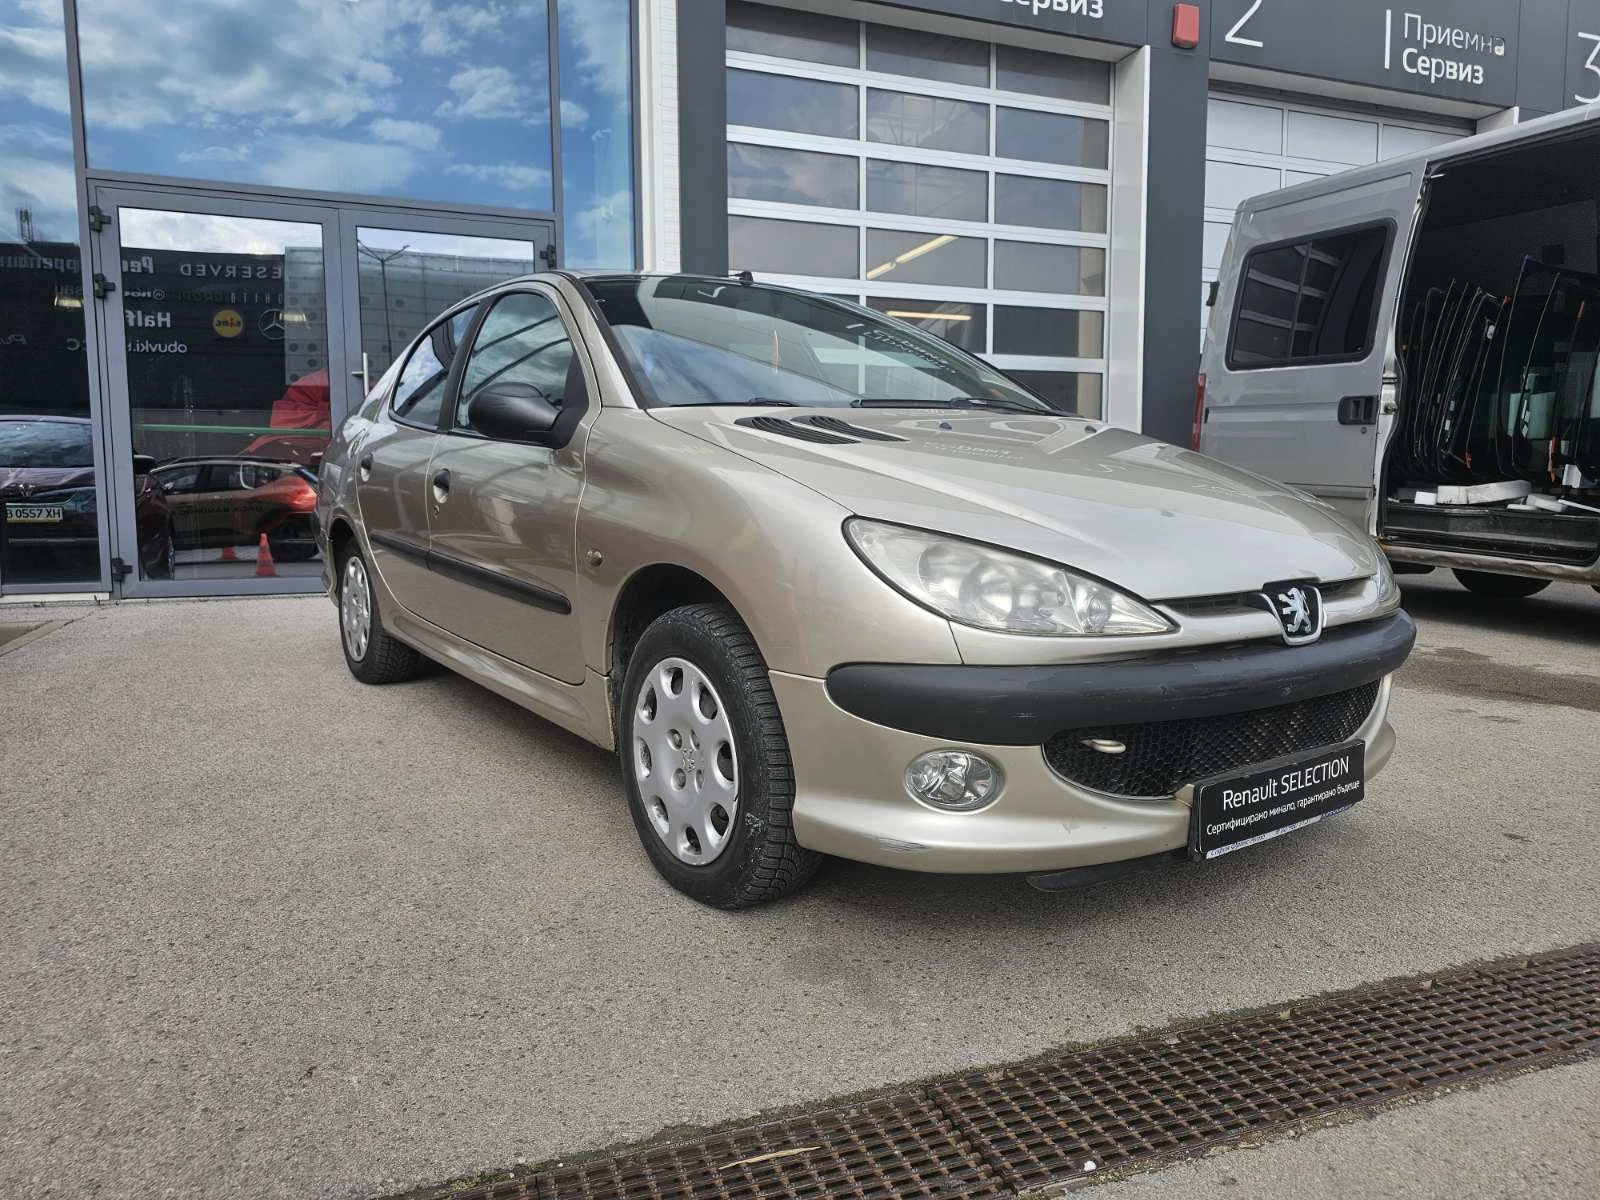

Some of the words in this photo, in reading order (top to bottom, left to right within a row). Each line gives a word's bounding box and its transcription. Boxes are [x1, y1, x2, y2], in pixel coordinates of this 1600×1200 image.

[1225, 0, 1263, 47] 2
[1404, 13, 1505, 56] Приемна
[1402, 48, 1484, 85] Сервиз
[1574, 32, 1600, 104] 3
[15, 508, 42, 519] 0557
[46, 508, 61, 519] XH
[1223, 778, 1277, 811] Renault
[1281, 756, 1350, 795] SELECTION
[1206, 810, 1268, 836] Сертифицирано
[1269, 804, 1295, 819] минало,
[1297, 788, 1337, 809] гарантирано
[1337, 779, 1361, 796] бъдеще
